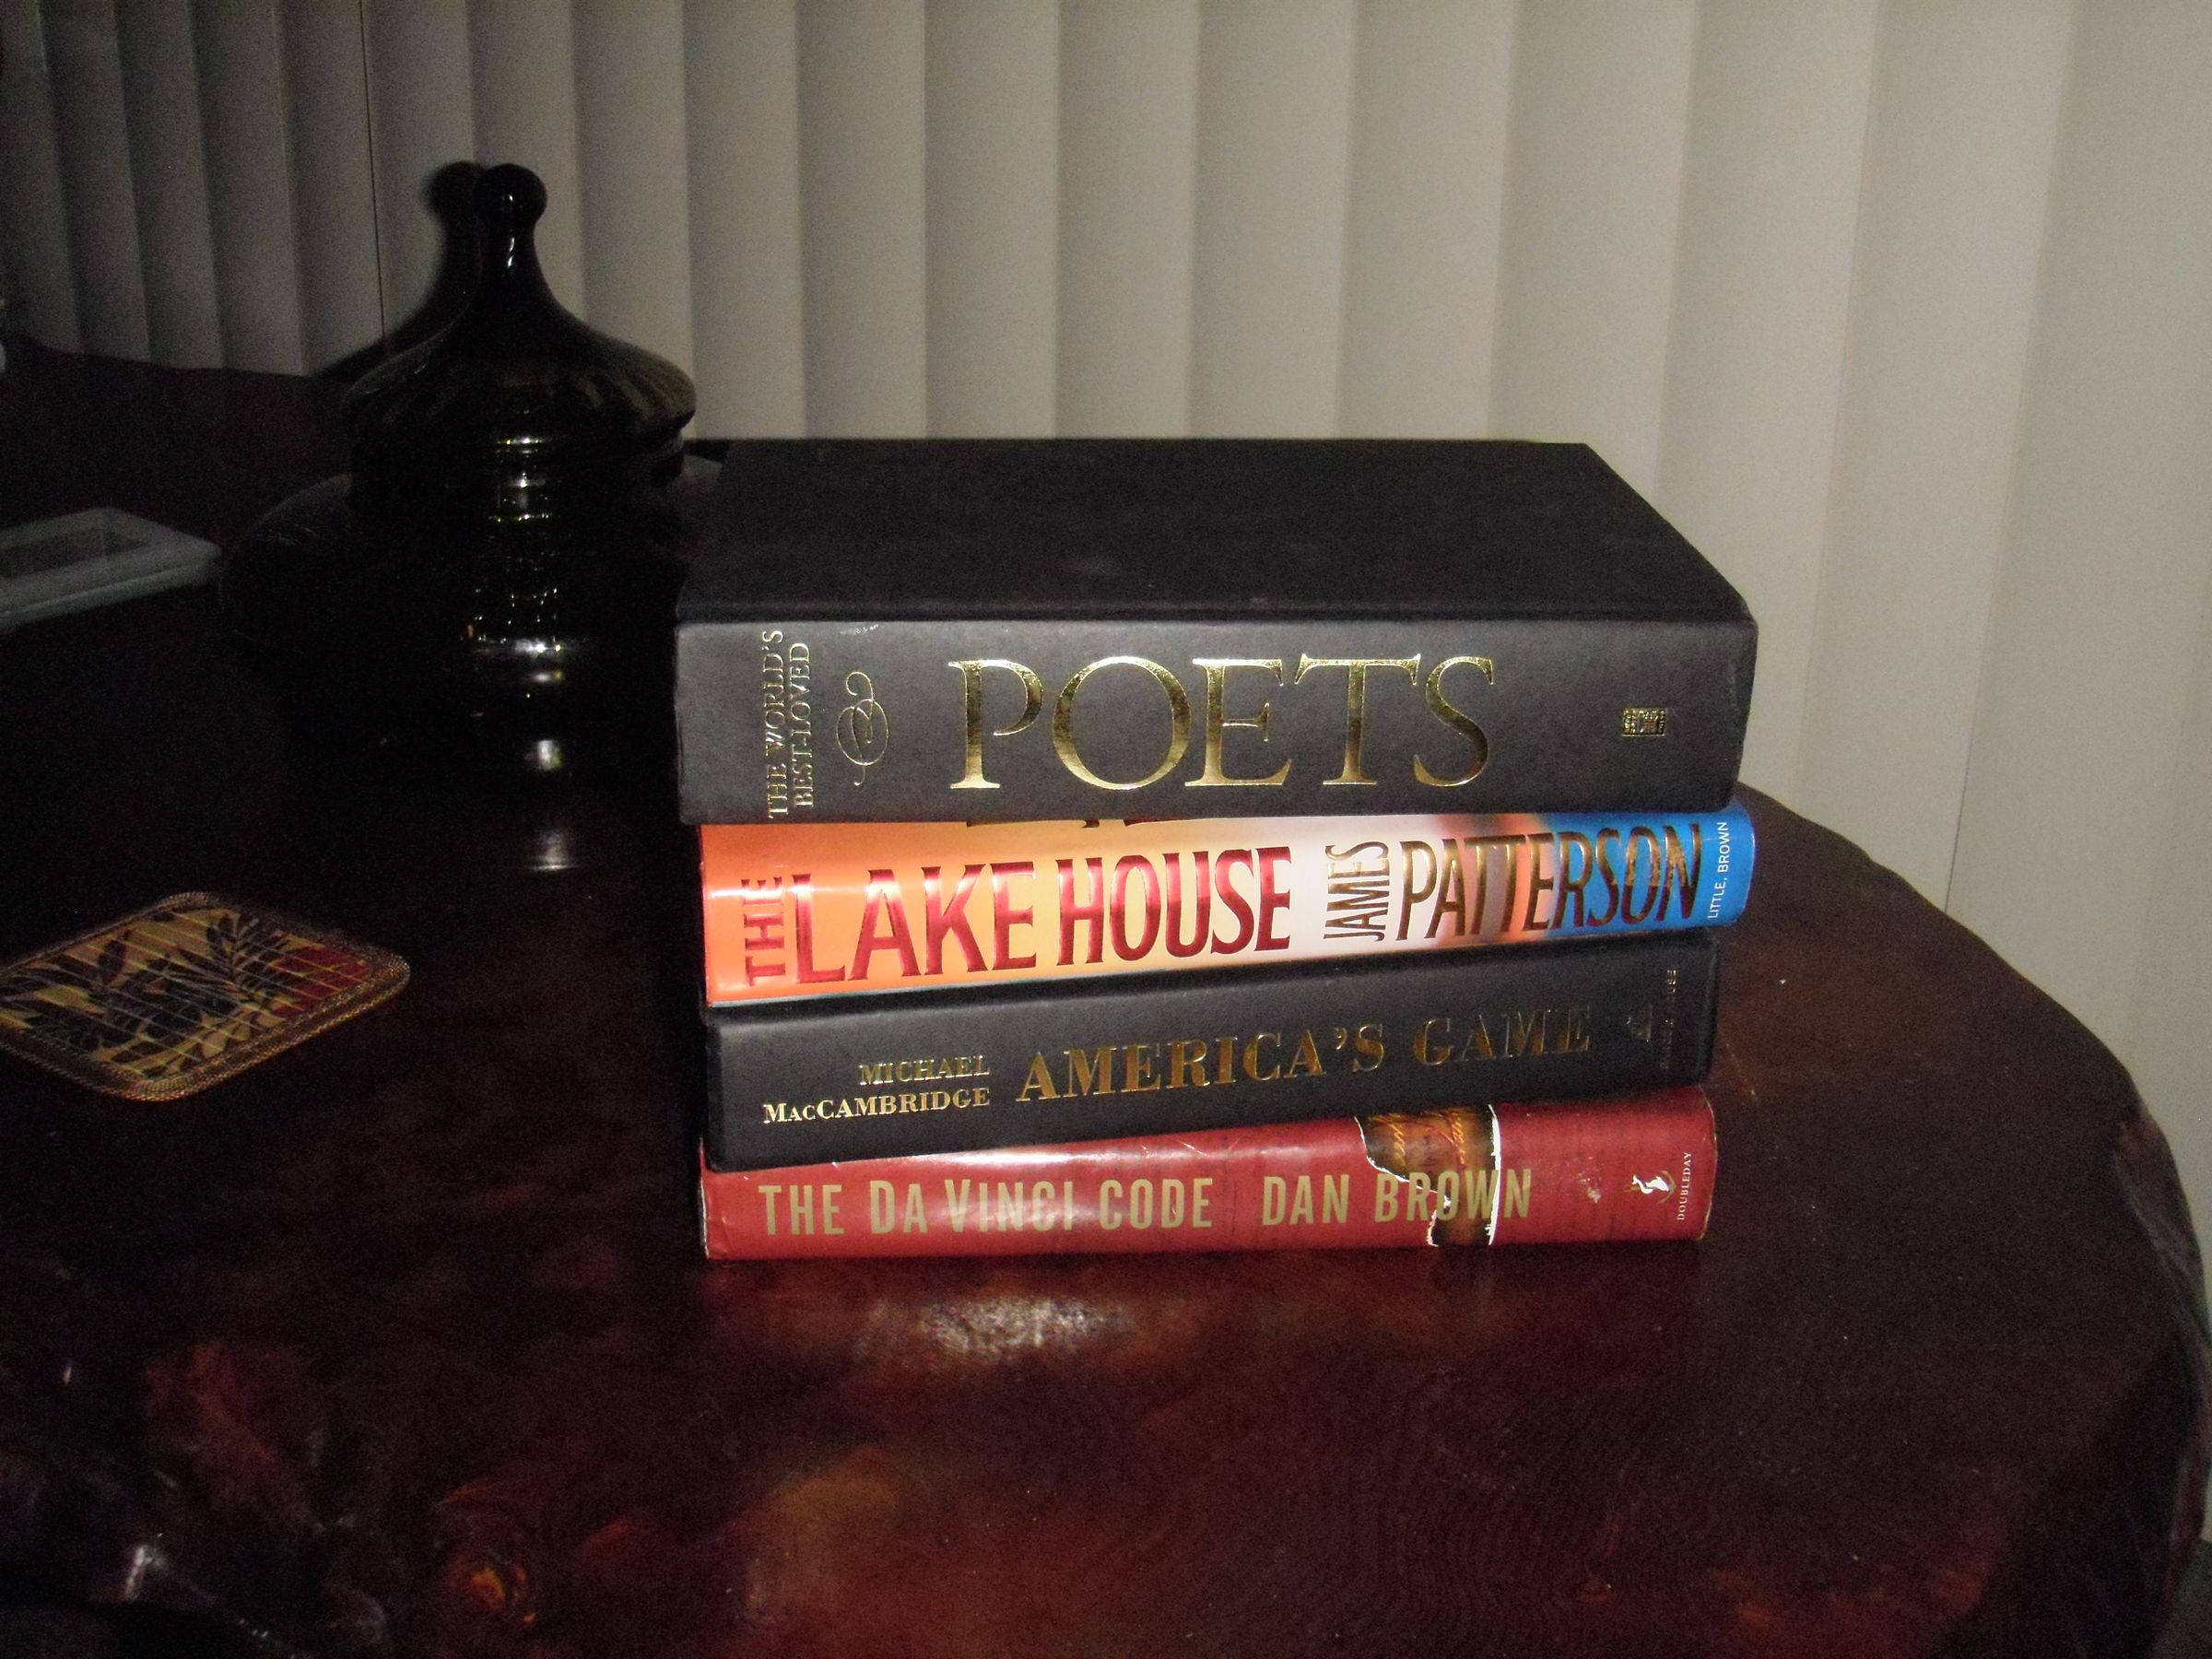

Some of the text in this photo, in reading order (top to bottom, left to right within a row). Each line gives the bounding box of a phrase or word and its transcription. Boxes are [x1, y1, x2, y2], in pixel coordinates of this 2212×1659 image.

[761, 630, 788, 818] THE WORLD'S
[789, 642, 814, 807] BEST-LOVED
[947, 653, 1496, 790] POETS
[741, 845, 1291, 986] THE LAKE HOUSE
[1324, 841, 1390, 942] JAMES
[1395, 823, 1702, 941] PATTERSON
[1707, 822, 1730, 919] LITTLE, BROWN
[858, 1054, 991, 1085] MICHAEL
[1017, 1023, 1386, 1102] AMERICA'S
[1412, 1006, 1592, 1066] GAME
[759, 1177, 1214, 1236] THE DA VINCI CODE
[1262, 1168, 1532, 1226] DAN BROWN
[1677, 1151, 1692, 1221] DOUBLEDAY
